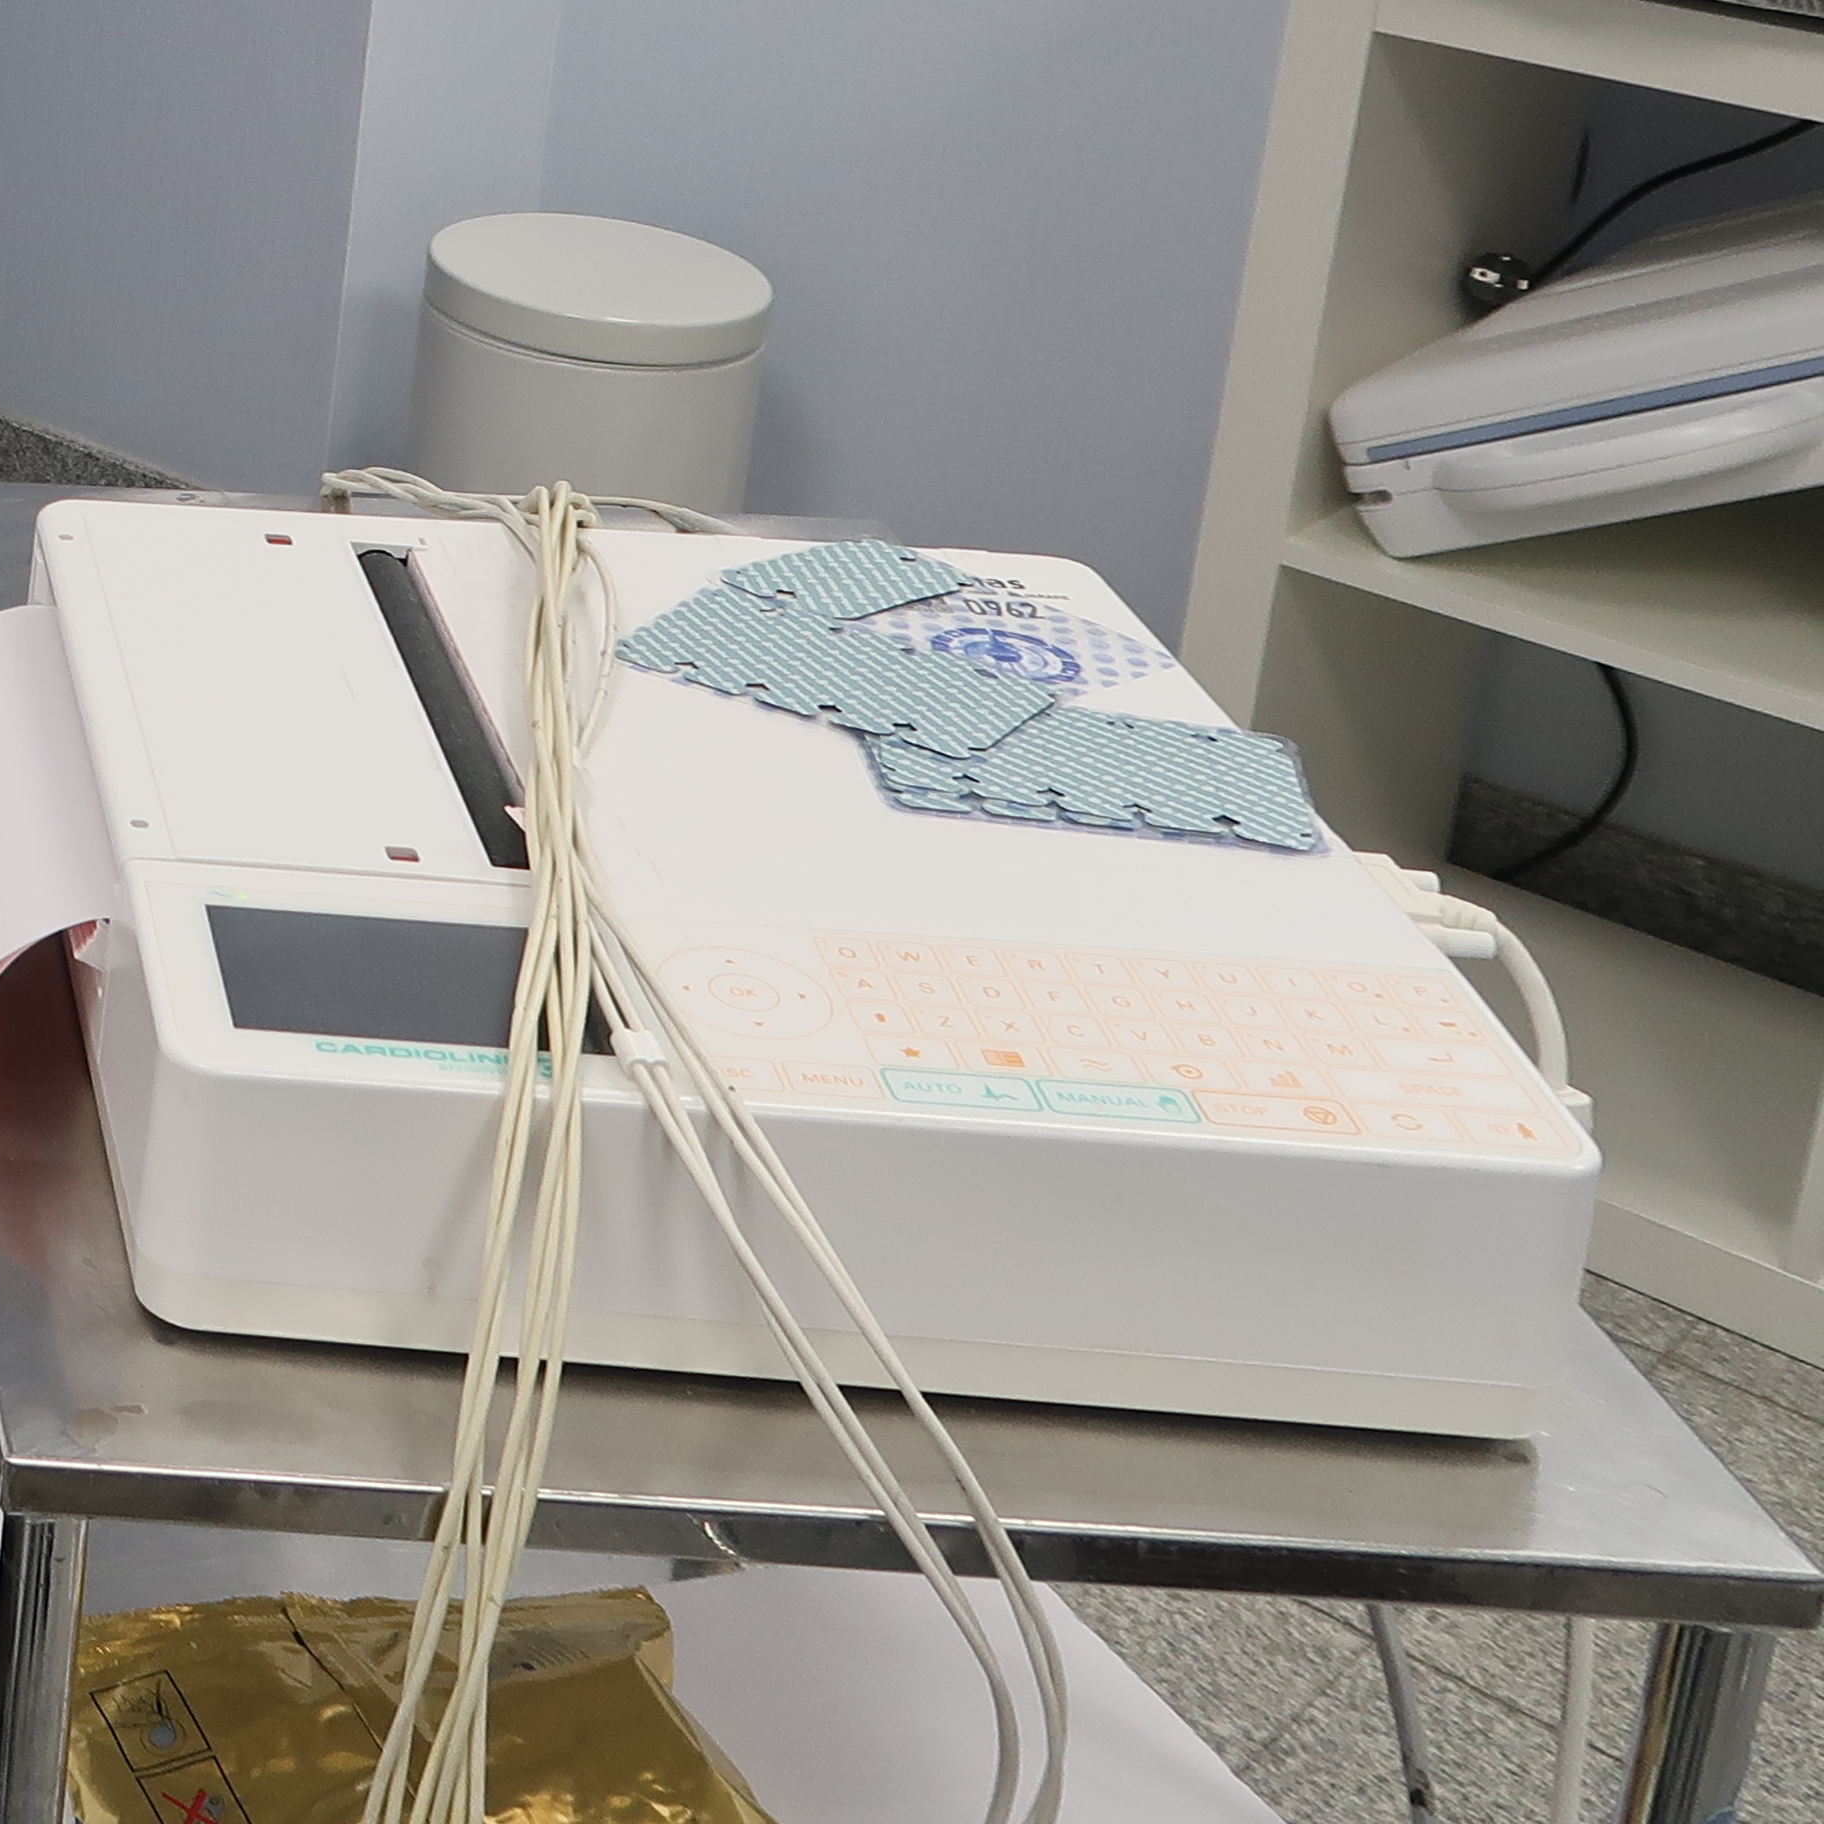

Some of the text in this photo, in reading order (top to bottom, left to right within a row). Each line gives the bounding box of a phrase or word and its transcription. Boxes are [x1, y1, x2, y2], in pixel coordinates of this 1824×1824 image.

[729, 986, 758, 999] OK
[315, 1041, 509, 1066] CARDIOLIN
[801, 1072, 864, 1087] MENU
[902, 1080, 962, 1095] AUTO
[1397, 1081, 1466, 1098] SPACE
[1056, 1091, 1149, 1109] MANUAL
[1213, 1102, 1269, 1117] STOP
